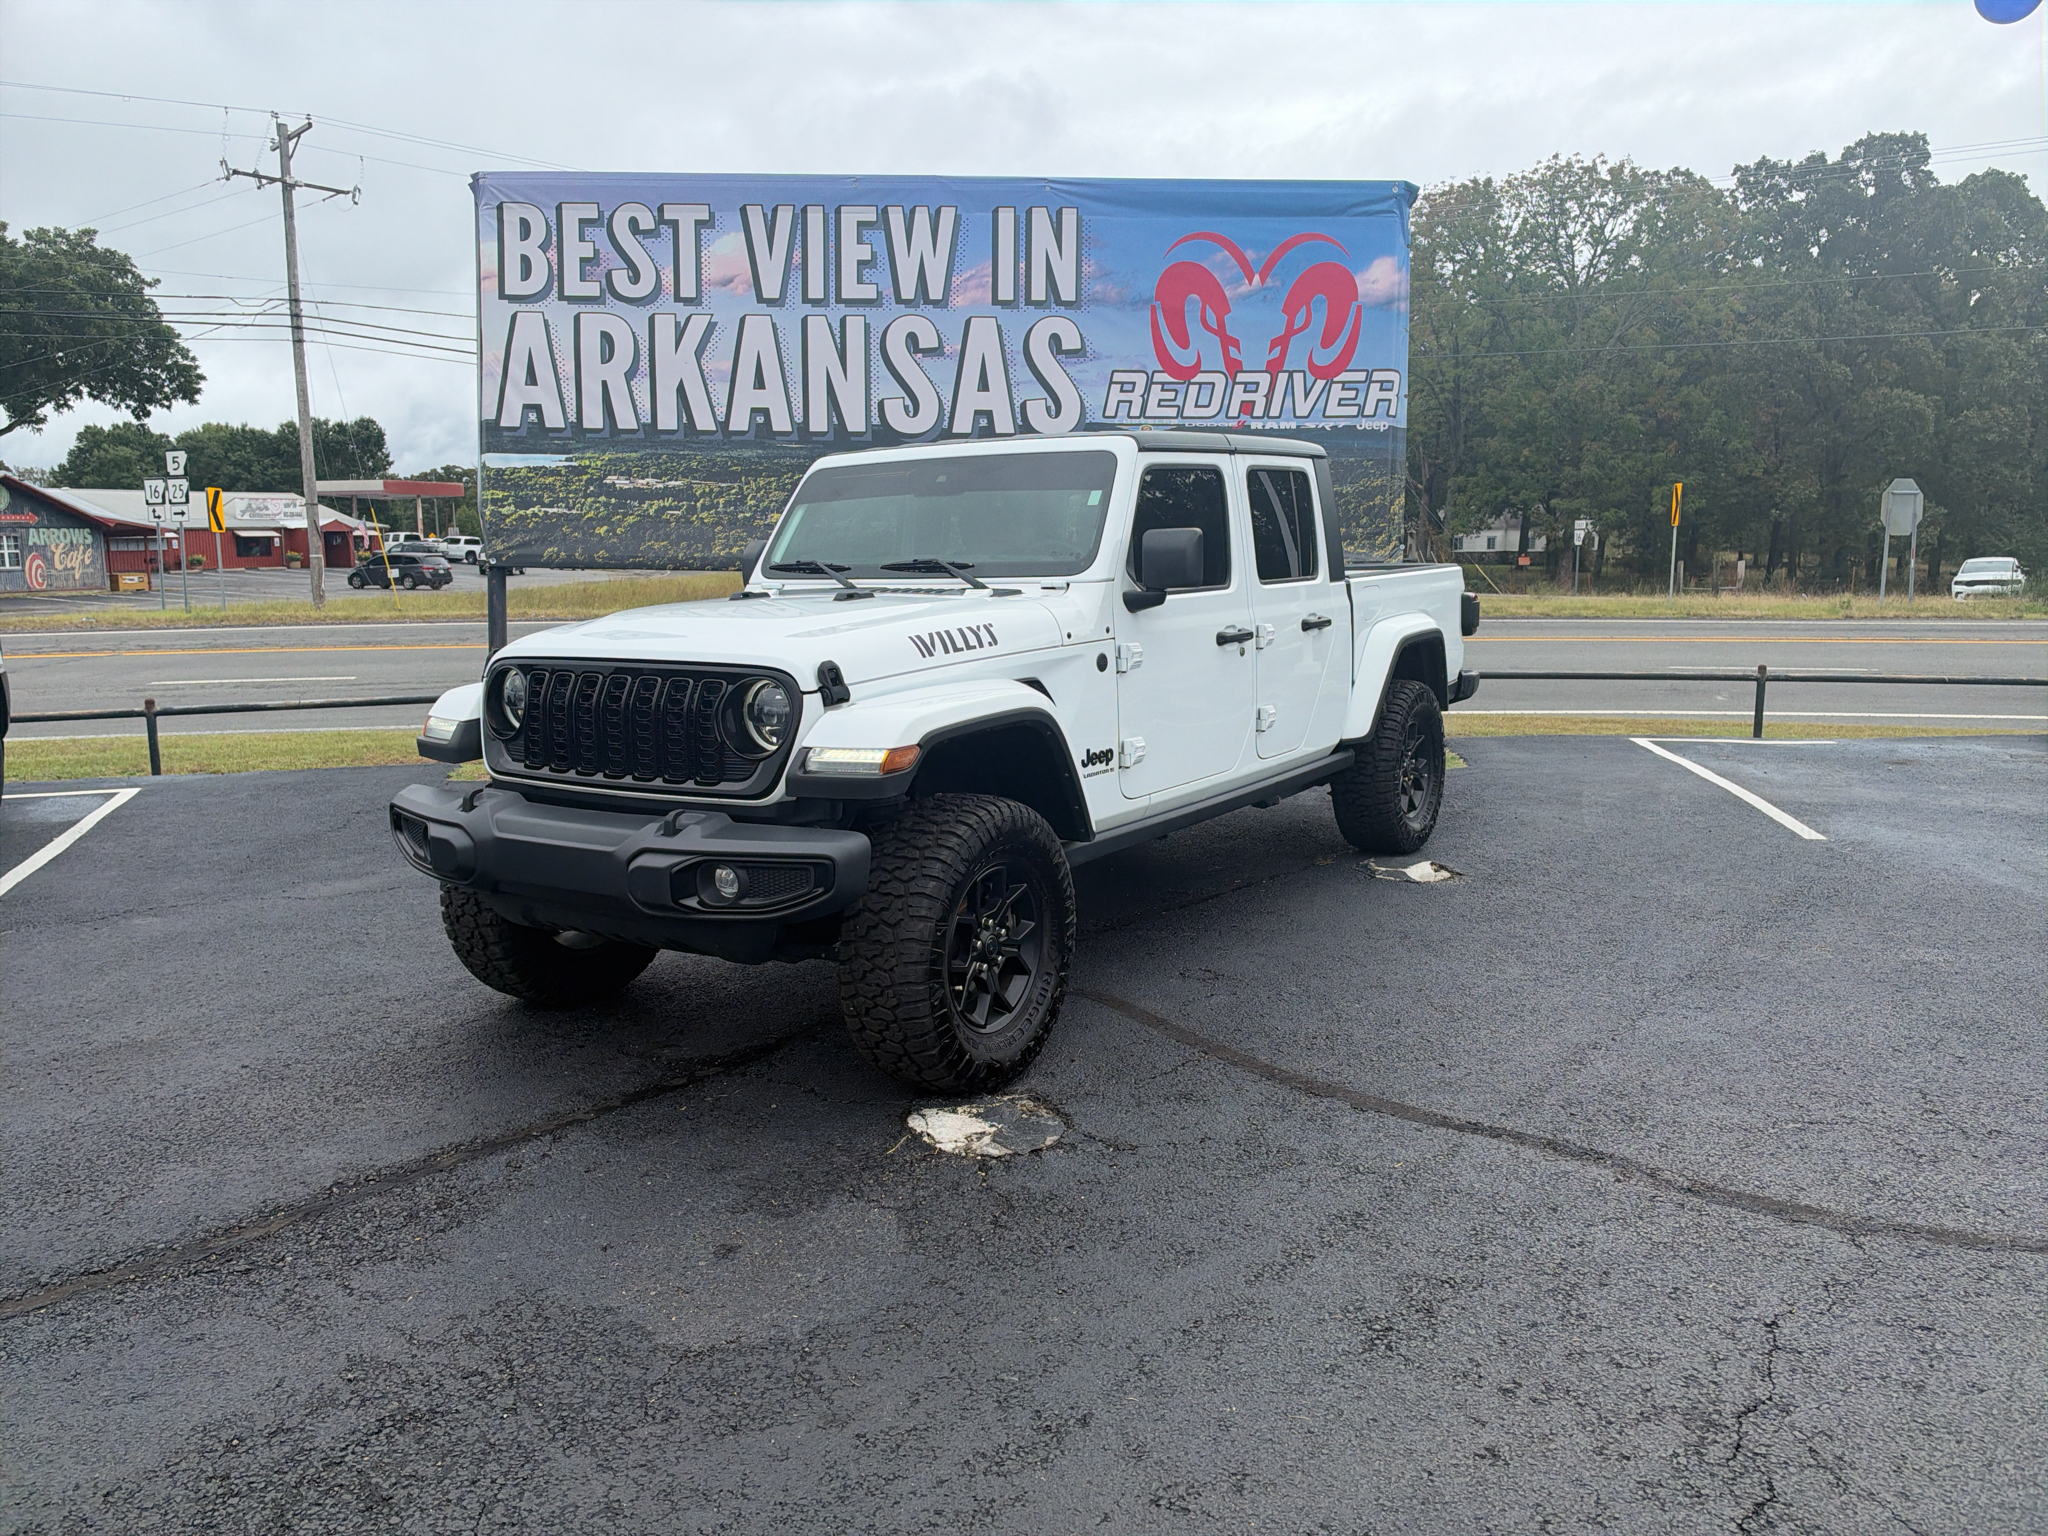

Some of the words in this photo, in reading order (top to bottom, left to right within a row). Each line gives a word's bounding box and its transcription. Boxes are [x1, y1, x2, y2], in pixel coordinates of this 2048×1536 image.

[498, 201, 714, 304] BEST
[740, 203, 958, 306] VIEW
[991, 205, 1083, 308] IN
[497, 310, 1084, 440] ARKANSAS
[1250, 421, 1297, 430] RAM
[1300, 421, 1352, 431] SRT
[1356, 418, 1389, 432] Jeep
[172, 456, 180, 471] 5
[149, 485, 160, 499] 16
[171, 484, 184, 499] 25
[28, 527, 93, 546] ARROWS
[50, 542, 92, 580] Cafe
[907, 623, 998, 659] WILLYS
[1081, 748, 1114, 768] Jeep
